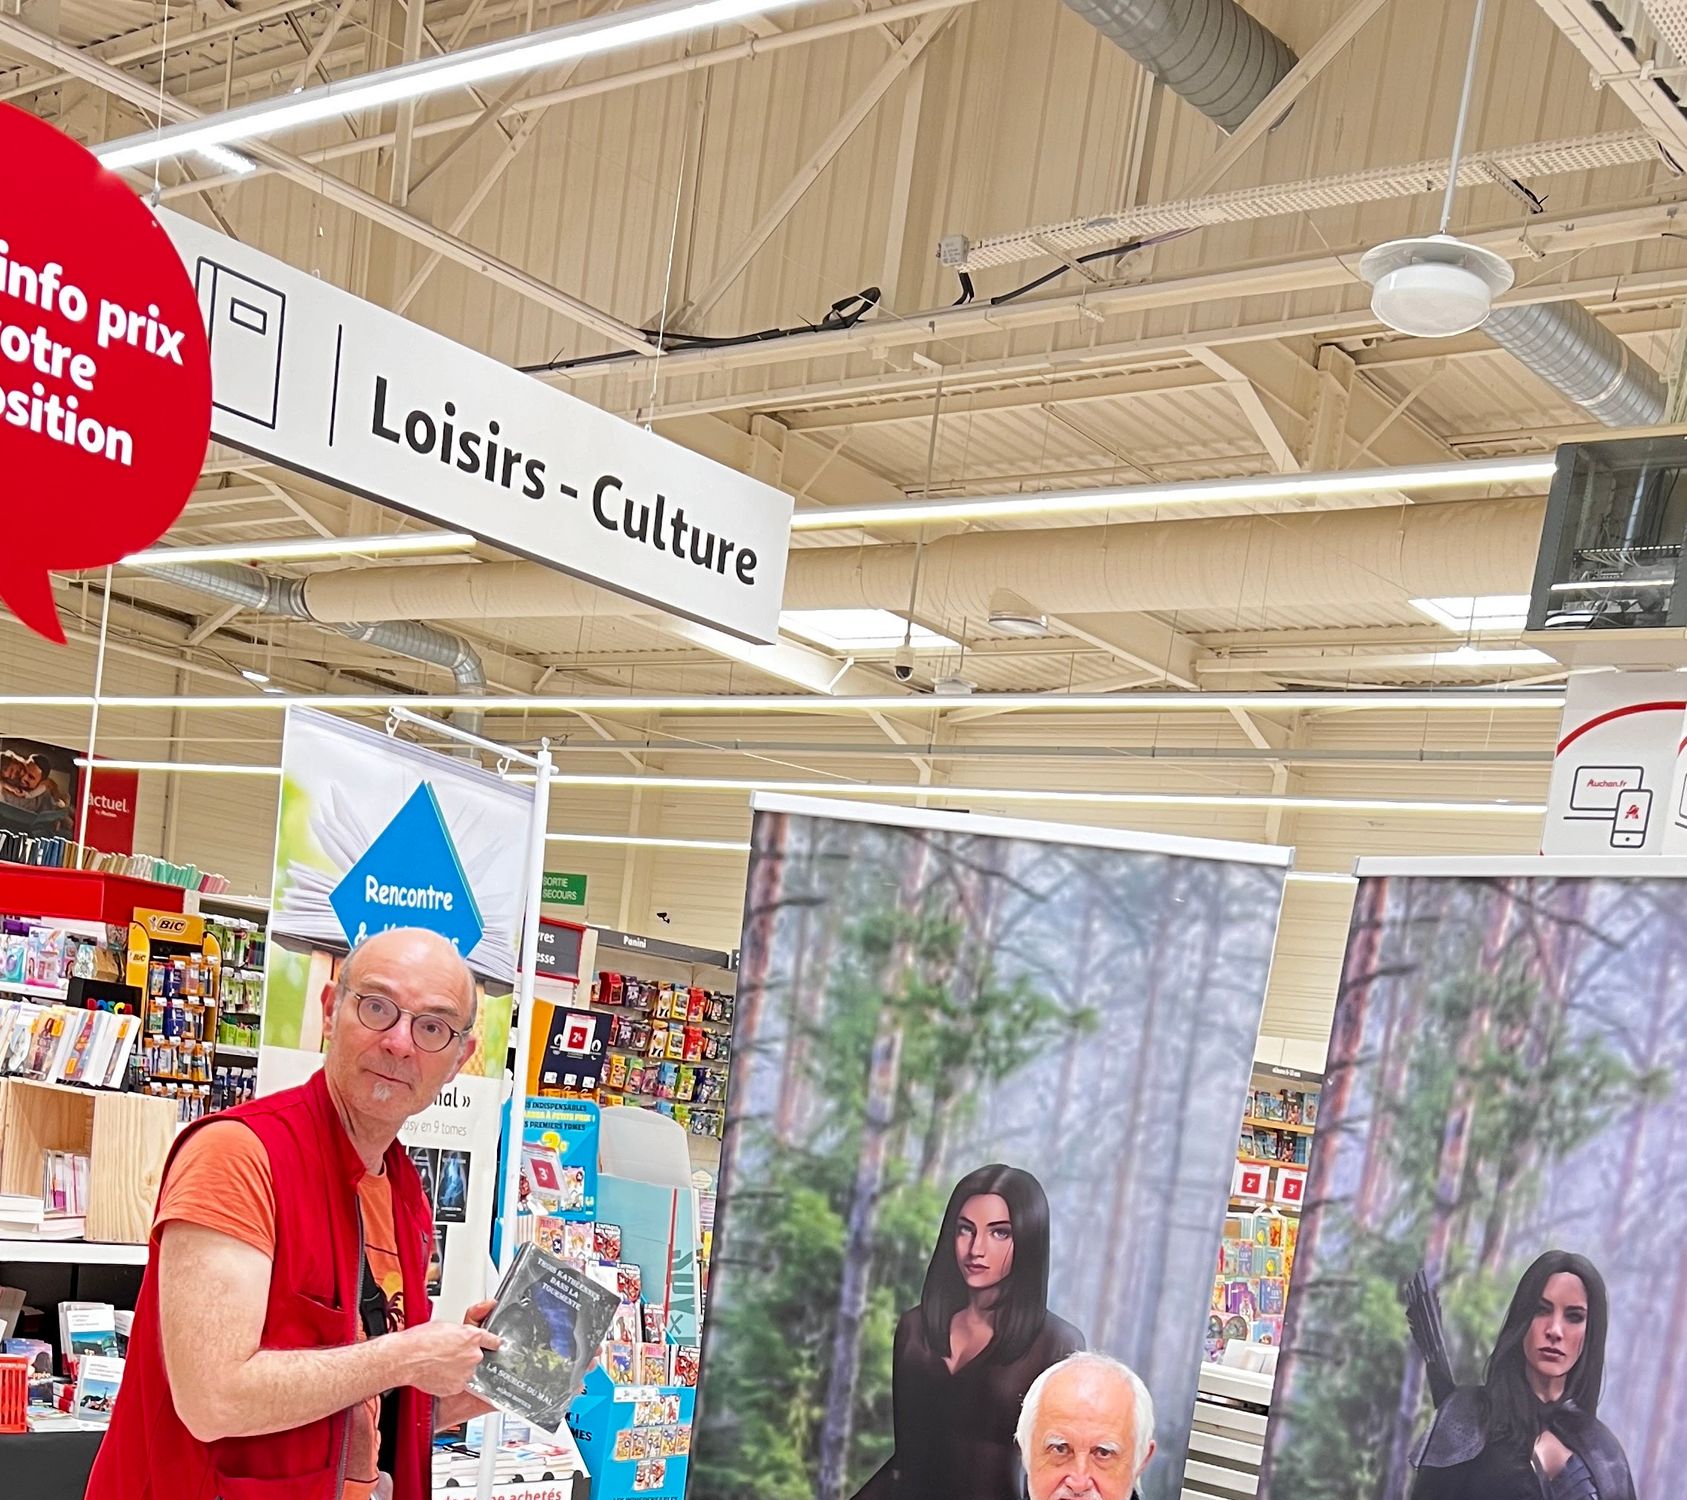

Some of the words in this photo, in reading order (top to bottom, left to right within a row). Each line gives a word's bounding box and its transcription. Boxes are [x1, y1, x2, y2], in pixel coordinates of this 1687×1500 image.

[98, 299, 185, 366] prix
[0, 324, 96, 390] otre
[0, 382, 133, 466] sition
[371, 375, 546, 500] Loisirs
[560, 483, 579, 500] -
[593, 475, 758, 585] Culture
[1586, 778, 1627, 787] Auchan.fr
[543, 876, 568, 888] SORTIE
[365, 874, 453, 912] Rencontre
[542, 889, 577, 901] SECOURS
[623, 936, 647, 949] Panini
[536, 952, 556, 965] esse
[532, 1102, 587, 1112] INDISPENSABLES
[402, 1120, 420, 1135] asy
[421, 1122, 432, 1133] en
[434, 1120, 440, 1134] 9
[441, 1123, 467, 1137] tomes
[529, 1121, 563, 1130] PREMIERS
[568, 1288, 579, 1299] LA
[486, 1362, 497, 1374] LA
[526, 1386, 538, 1396] DU
[536, 1393, 553, 1407] MAL
